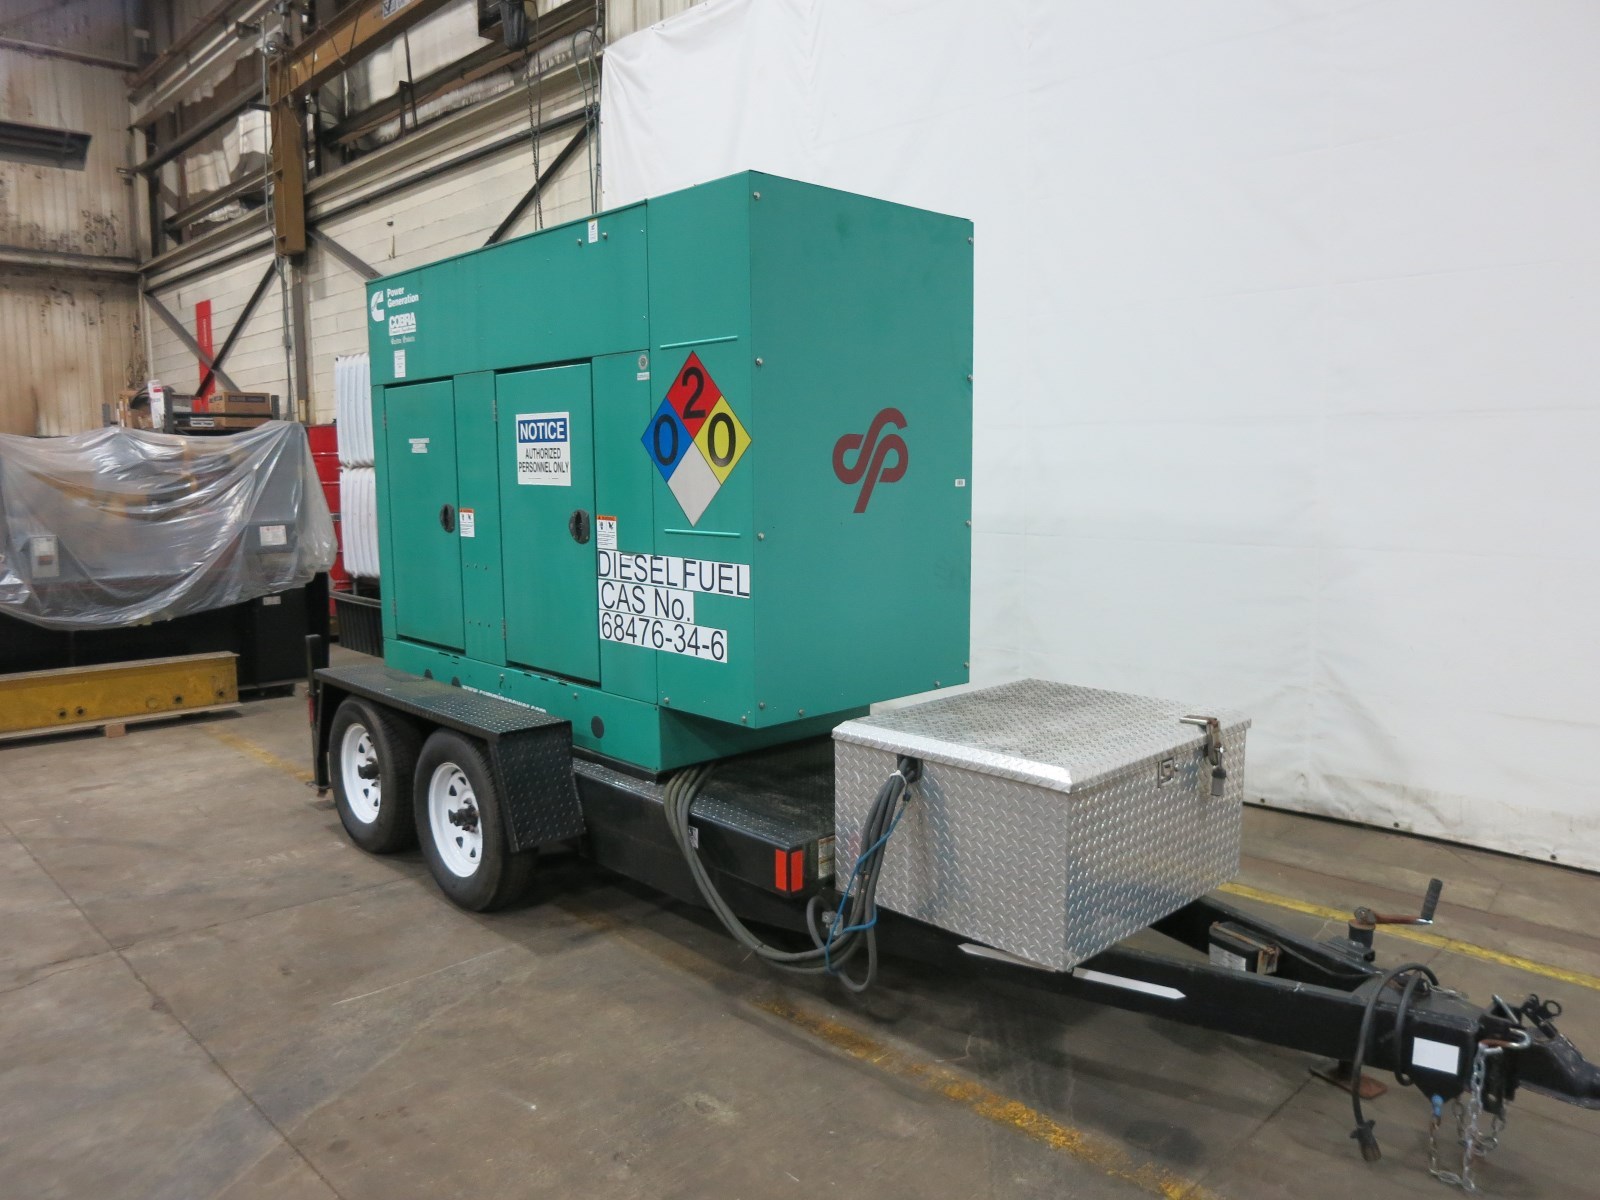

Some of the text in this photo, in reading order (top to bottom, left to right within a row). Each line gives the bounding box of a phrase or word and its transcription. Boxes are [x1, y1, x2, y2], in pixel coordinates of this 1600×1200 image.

[387, 287, 405, 298] Power
[387, 293, 419, 308] Generation
[389, 312, 417, 329] COBRA
[682, 366, 706, 420] 2
[520, 421, 565, 440] NOTICE
[653, 414, 679, 466] 0
[707, 412, 736, 467] 0
[519, 461, 569, 473] PERSONNEL ONLY
[525, 448, 561, 459] AUTHORIZED
[598, 550, 750, 597] DIESEL FUEL
[601, 581, 690, 622] CAS No.
[601, 612, 725, 661] 68476-34-6
